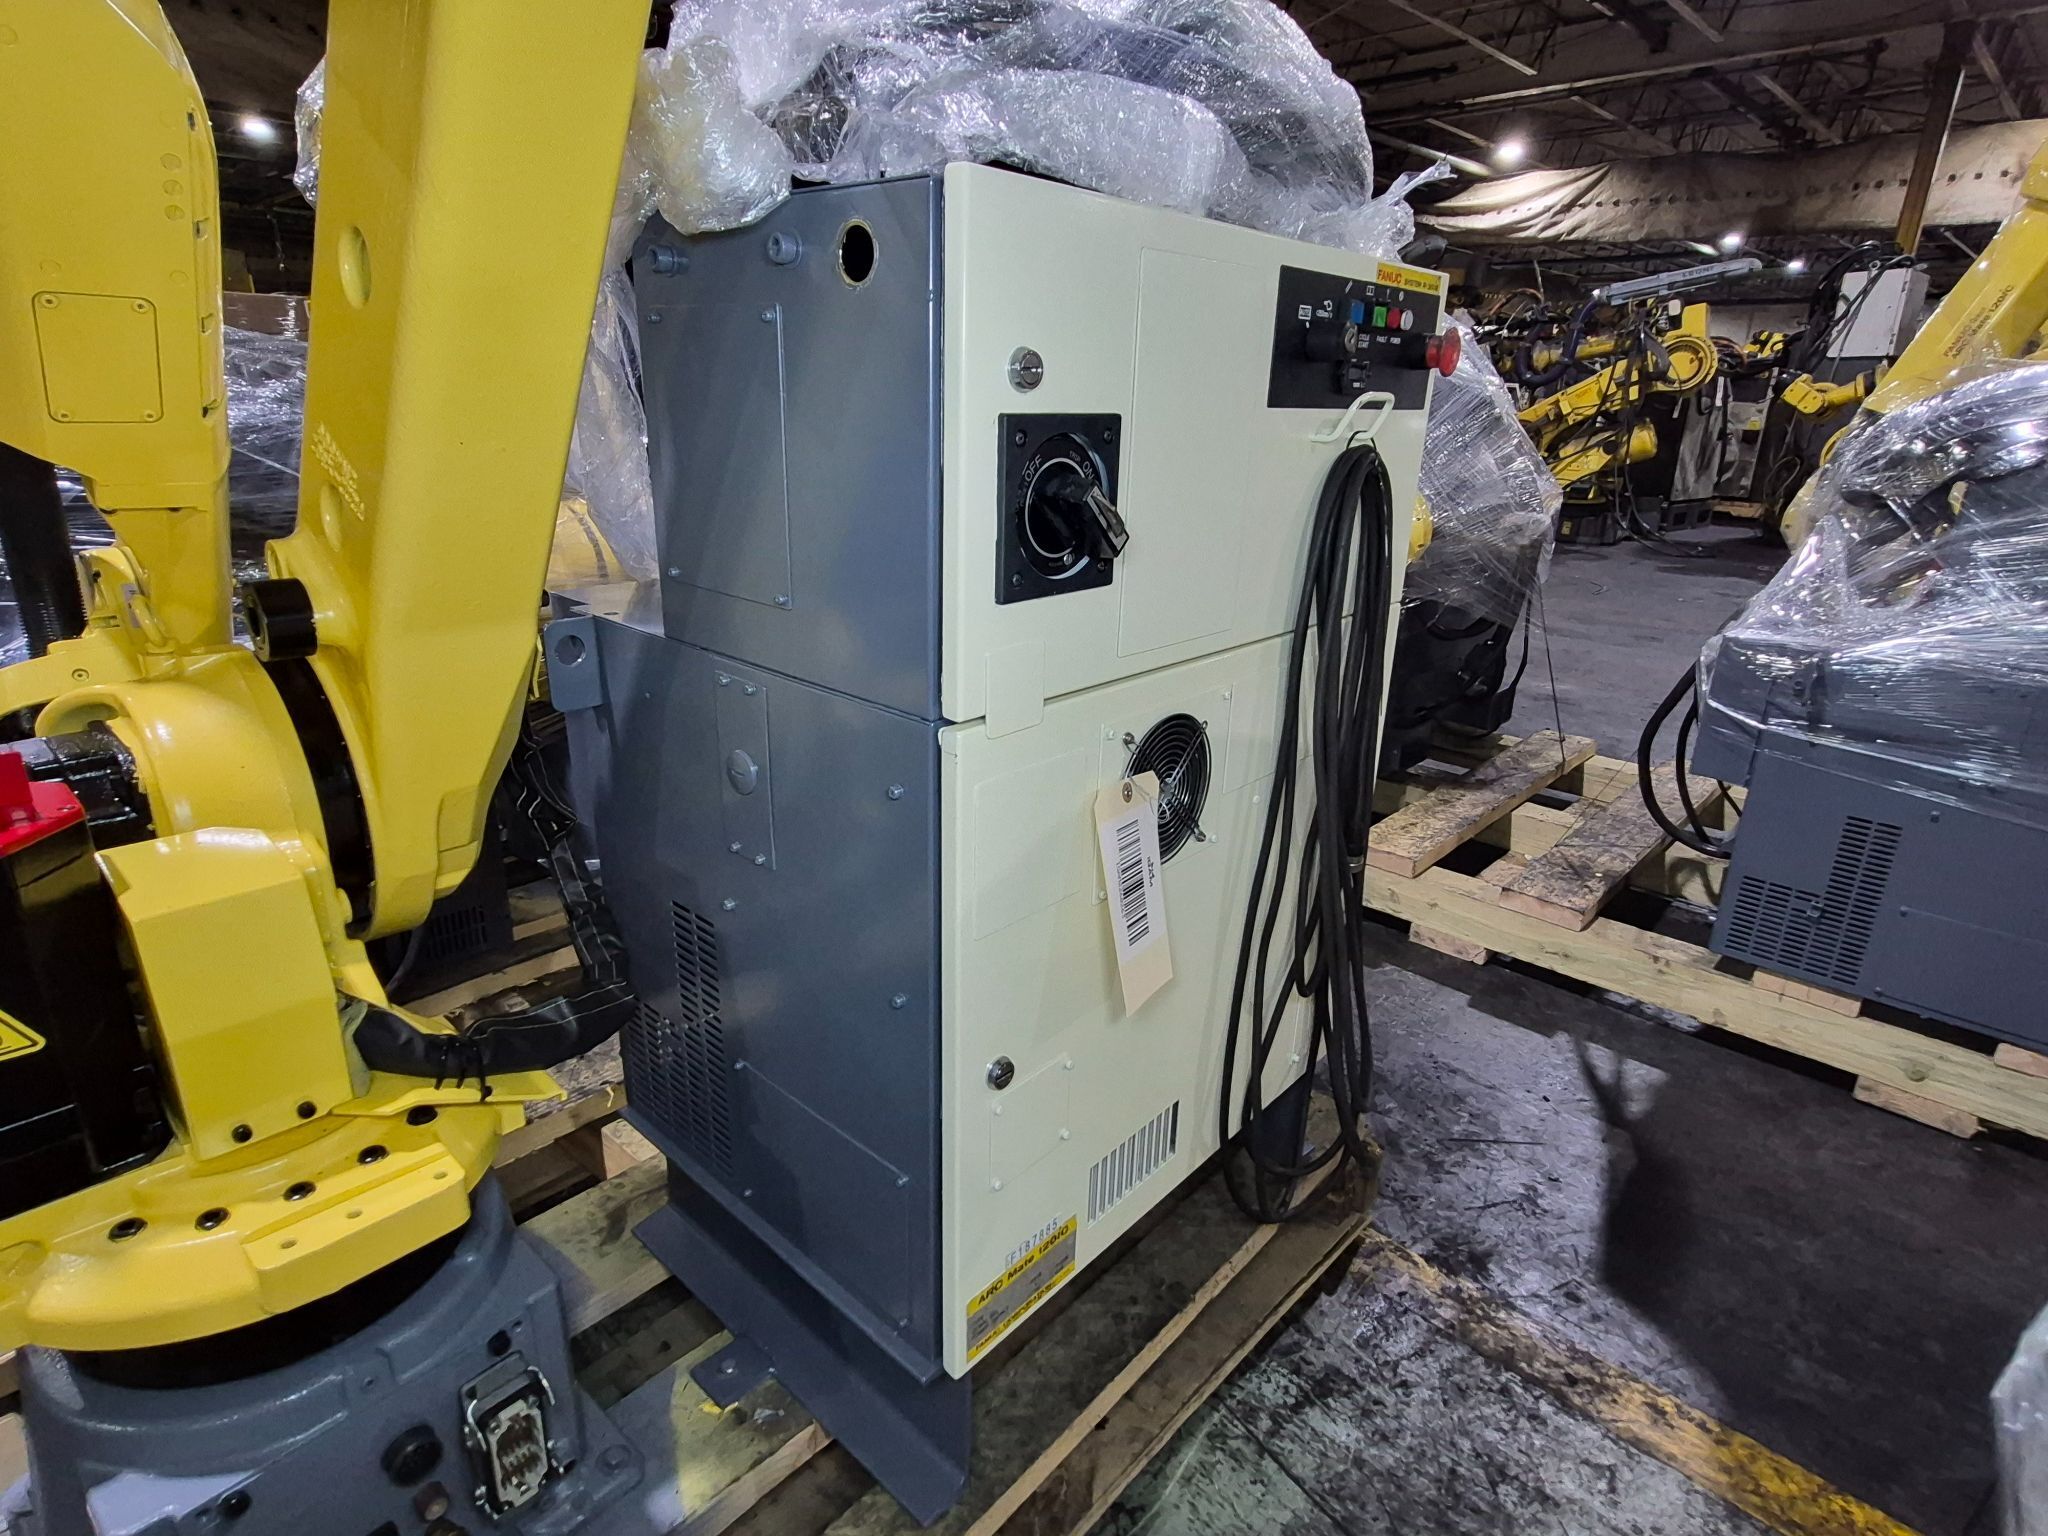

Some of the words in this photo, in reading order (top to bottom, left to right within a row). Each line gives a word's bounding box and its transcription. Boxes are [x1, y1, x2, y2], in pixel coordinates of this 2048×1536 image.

[1377, 269, 1402, 284] FANUC
[1024, 454, 1042, 482] OFF
[1082, 461, 1096, 480] ON
[977, 1279, 1004, 1305] ARC
[1007, 1255, 1035, 1280] Mate
